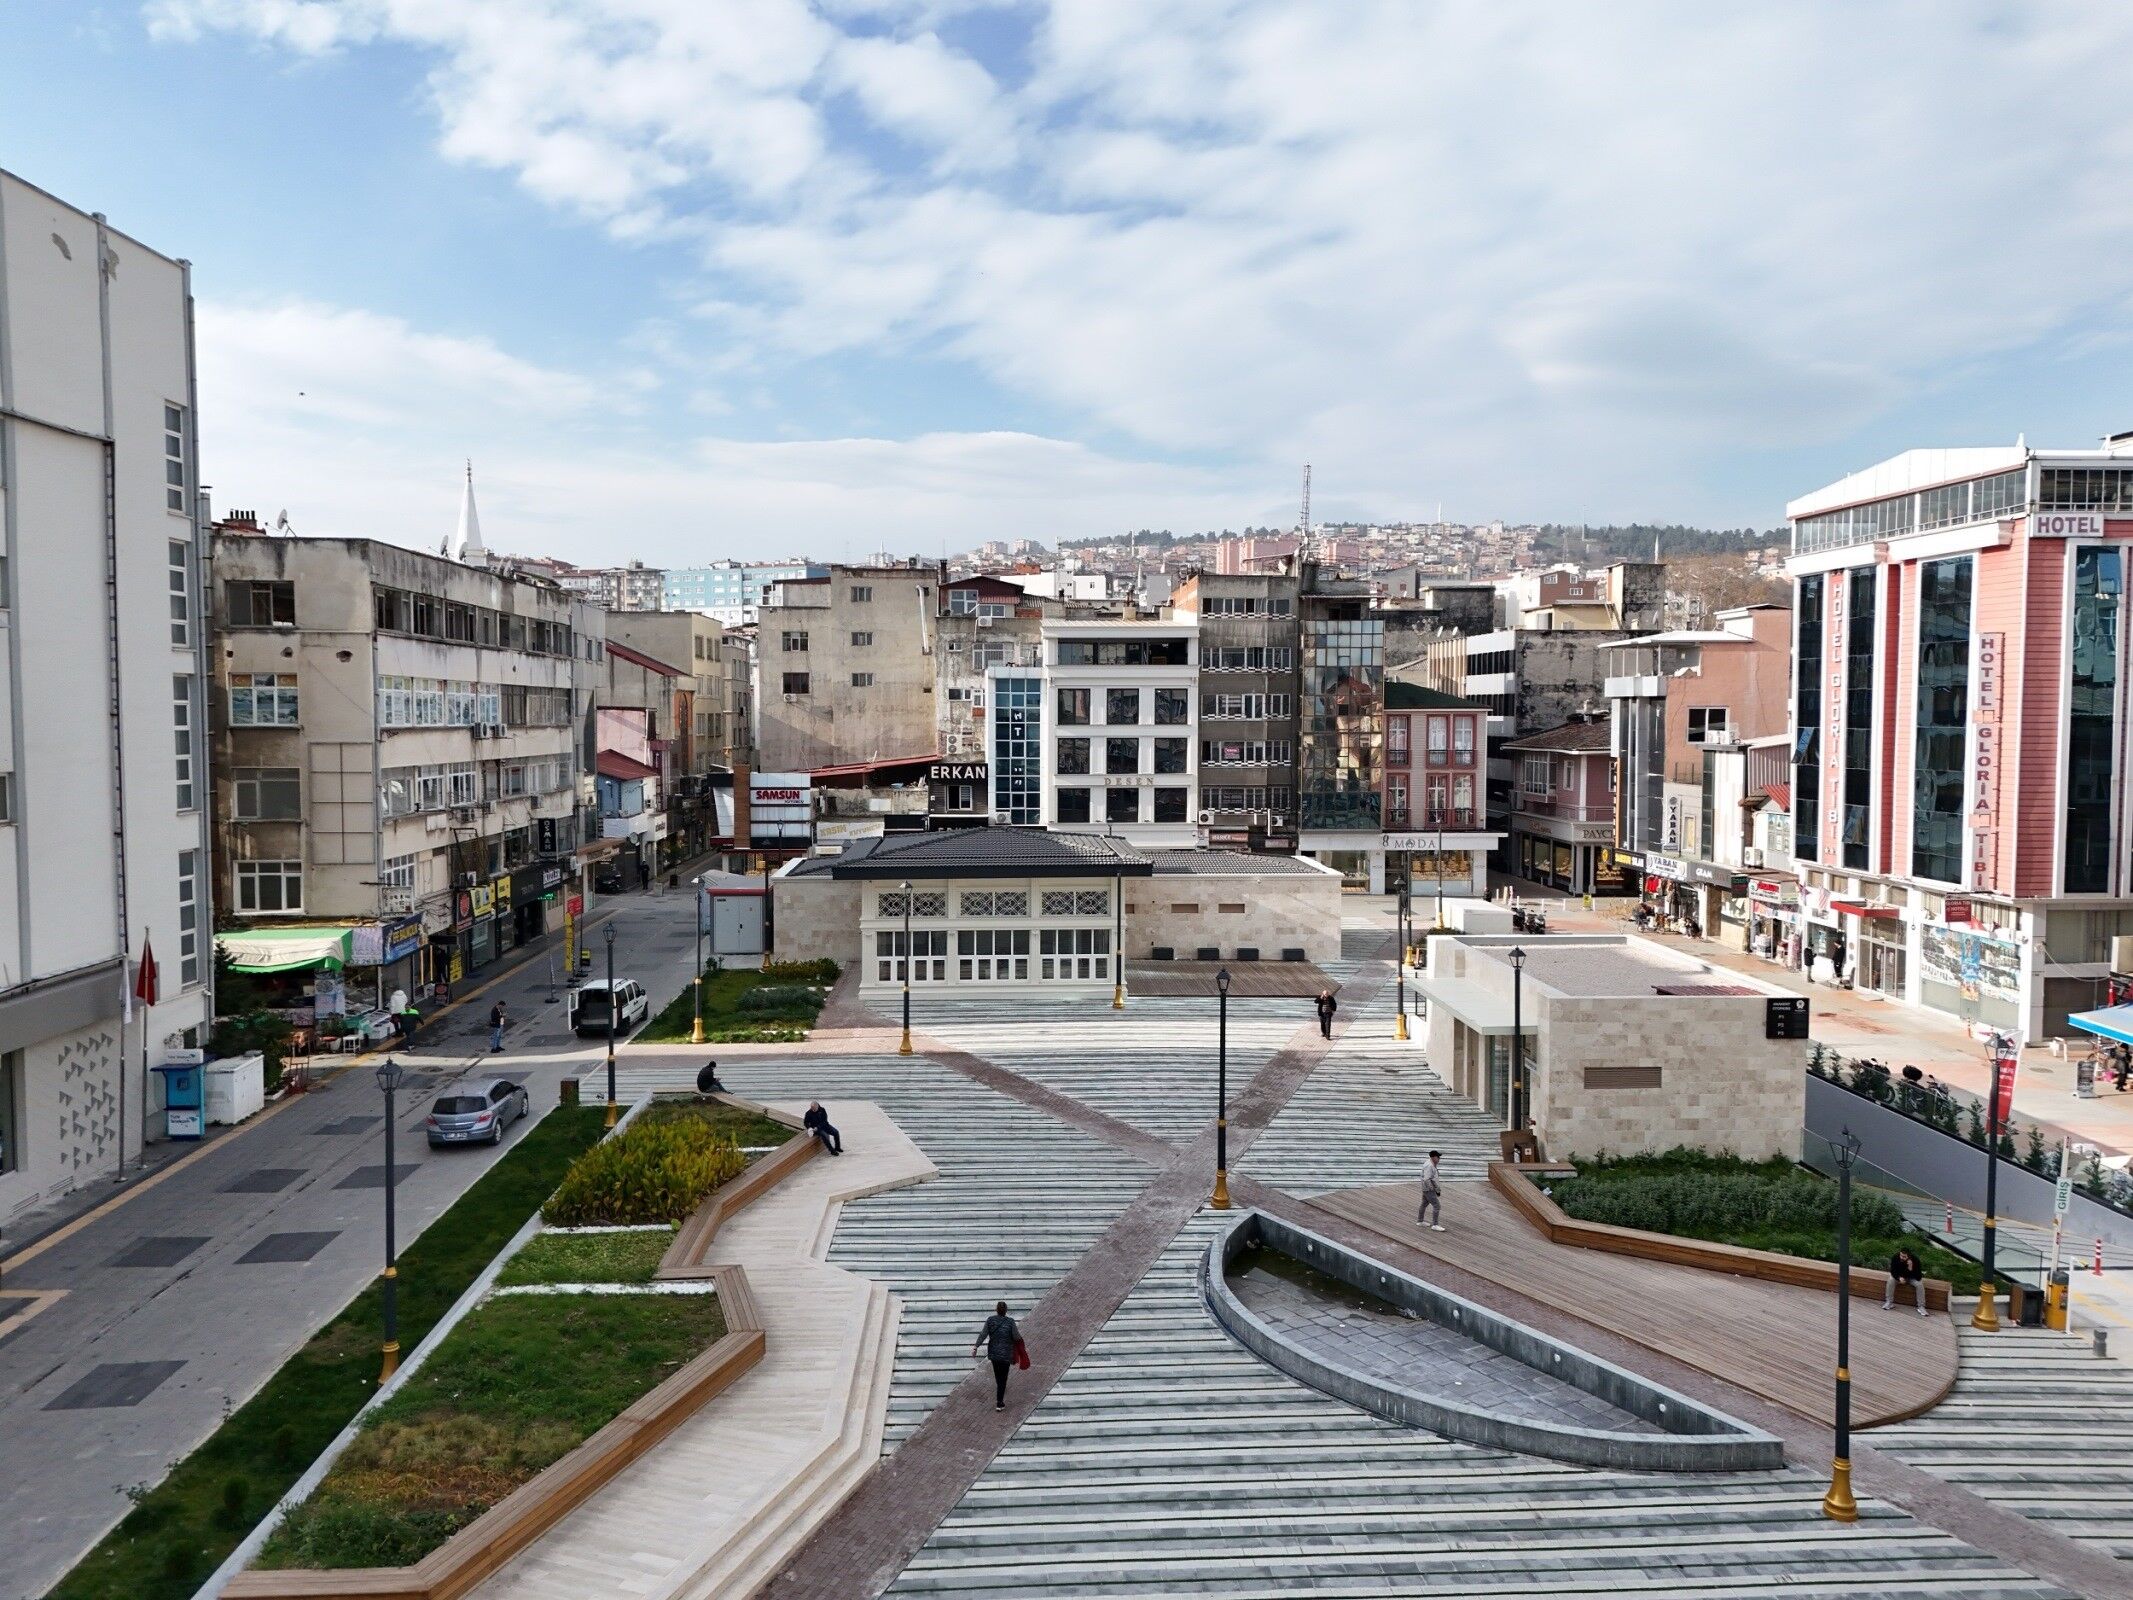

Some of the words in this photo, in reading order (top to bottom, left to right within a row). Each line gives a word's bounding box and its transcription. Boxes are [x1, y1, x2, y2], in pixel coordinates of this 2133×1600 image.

[2036, 516, 2100, 534] HOTEL
[1830, 582, 1843, 664] HOTEL
[1980, 637, 1995, 706] HOTEL
[930, 765, 987, 780] ERKAN
[1103, 776, 1156, 786] DESEN
[755, 790, 801, 801] SAMSUN
[543, 819, 552, 850] OSMAN
[1668, 805, 1678, 844] YABAN
[1394, 838, 1437, 849] MODA
[2057, 1180, 2070, 1210] GİRİŞ
